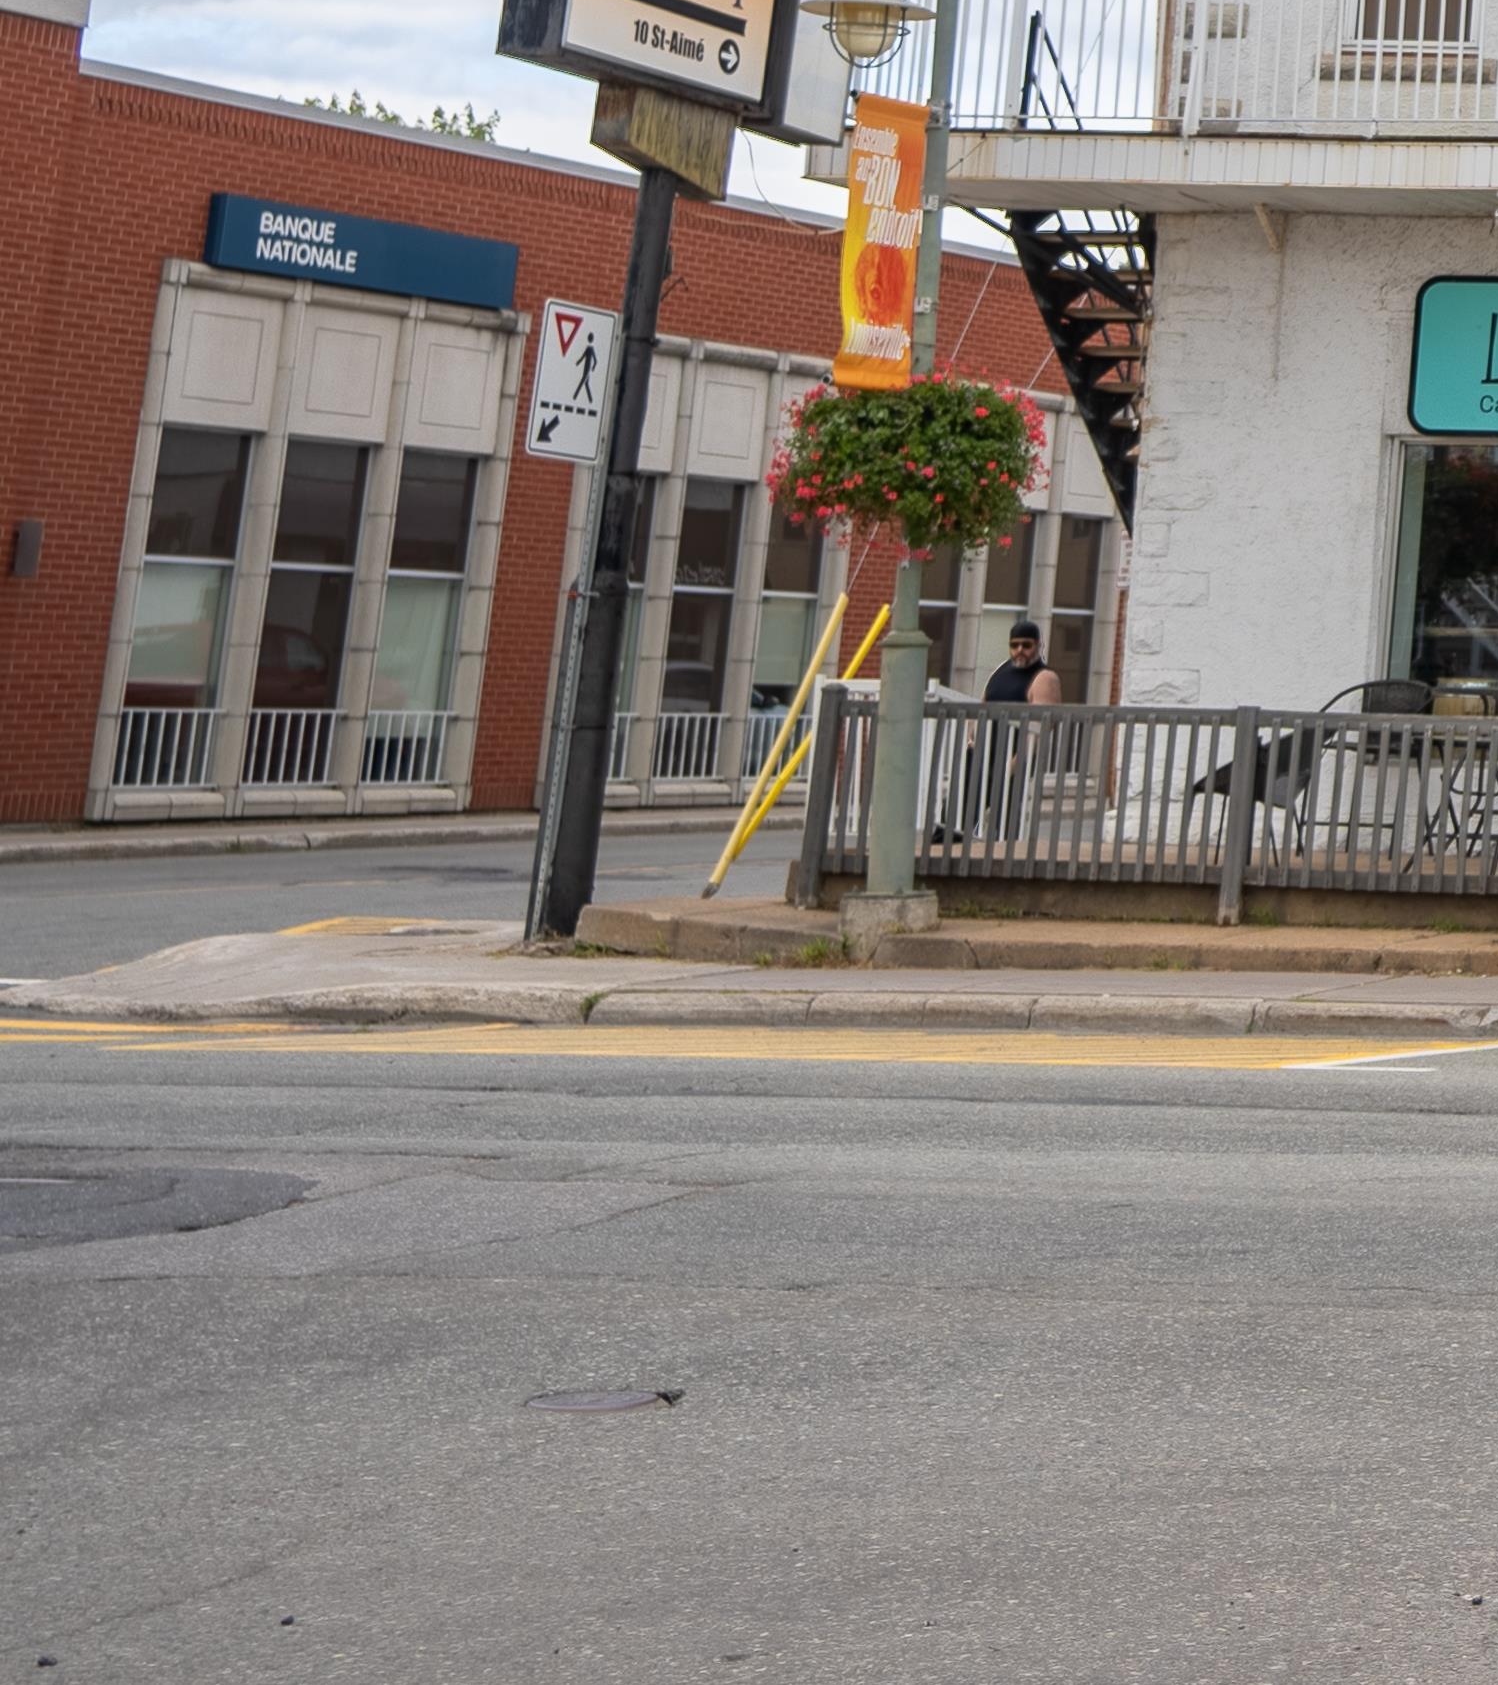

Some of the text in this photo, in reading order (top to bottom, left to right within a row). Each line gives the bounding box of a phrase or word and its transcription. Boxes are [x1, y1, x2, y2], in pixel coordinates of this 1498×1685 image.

[633, 19, 705, 63] 10 St-Aimé
[863, 155, 901, 208] BON
[259, 211, 336, 244] BANQUE
[256, 240, 358, 273] NATIONALE
